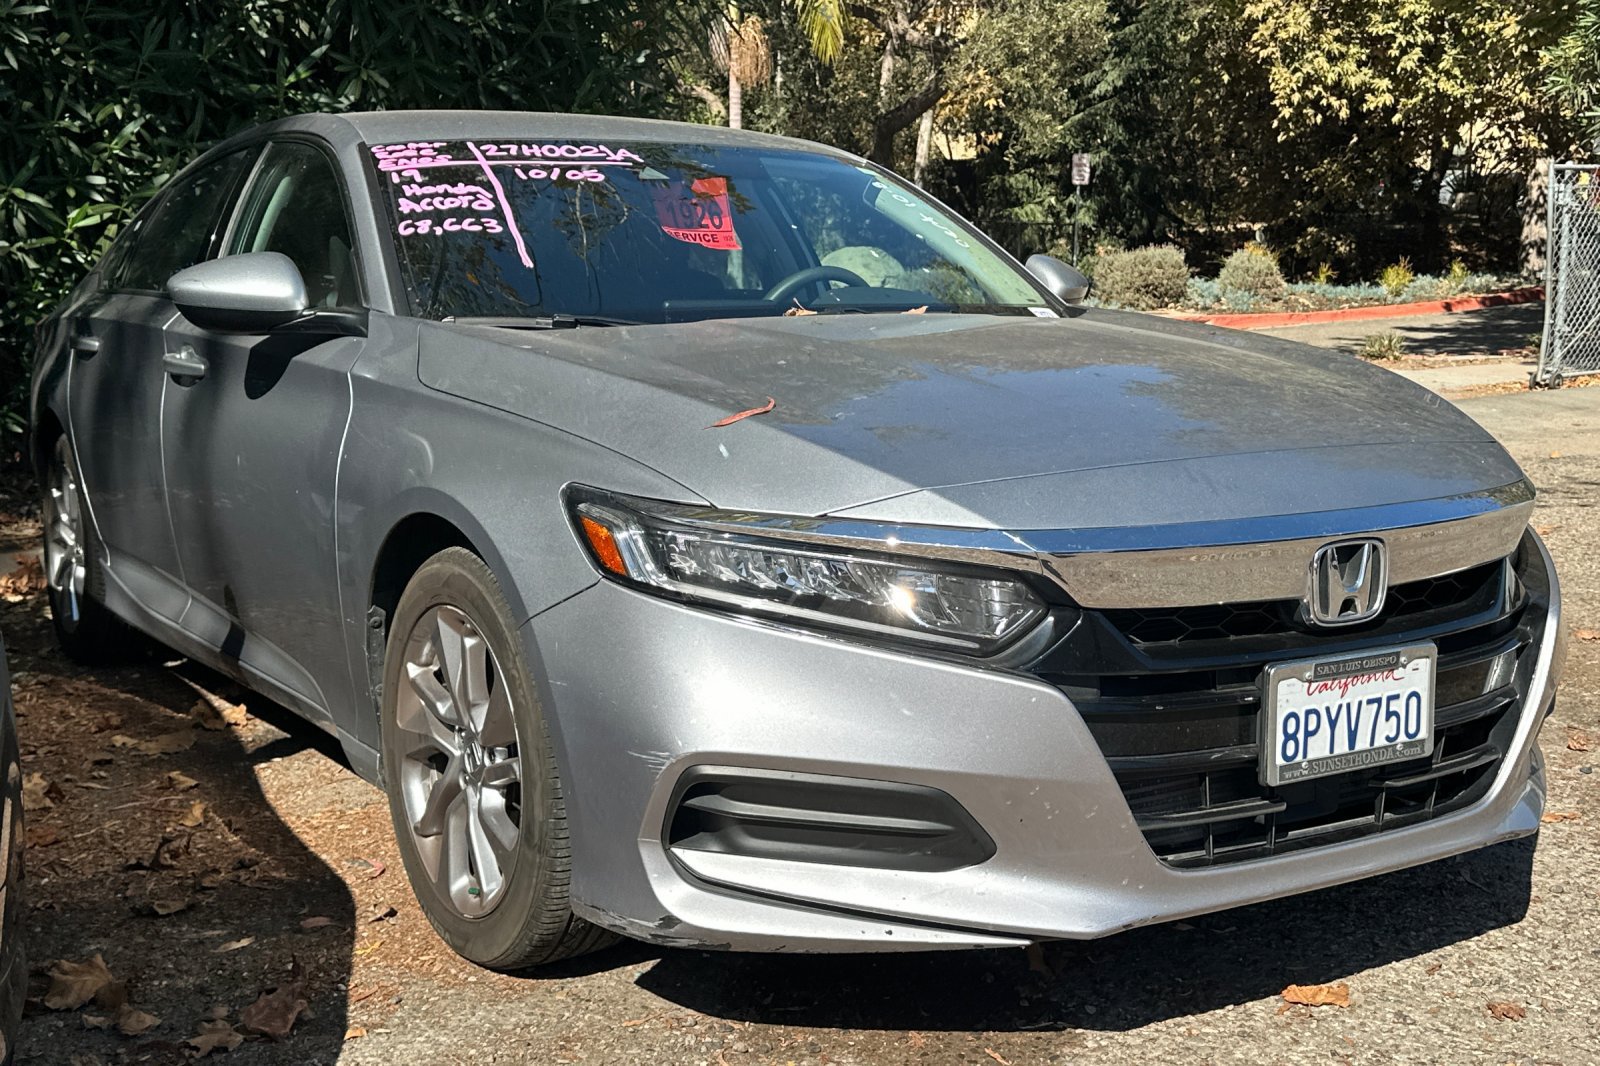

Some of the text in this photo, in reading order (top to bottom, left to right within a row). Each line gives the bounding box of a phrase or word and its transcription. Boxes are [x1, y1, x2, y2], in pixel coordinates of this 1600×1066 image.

[391, 168, 423, 183] 19
[514, 167, 606, 182] 10/05
[398, 194, 495, 214] Accord
[1316, 655, 1397, 676] SAN LUIS OBISPO
[1280, 690, 1422, 763] 8PYV750
